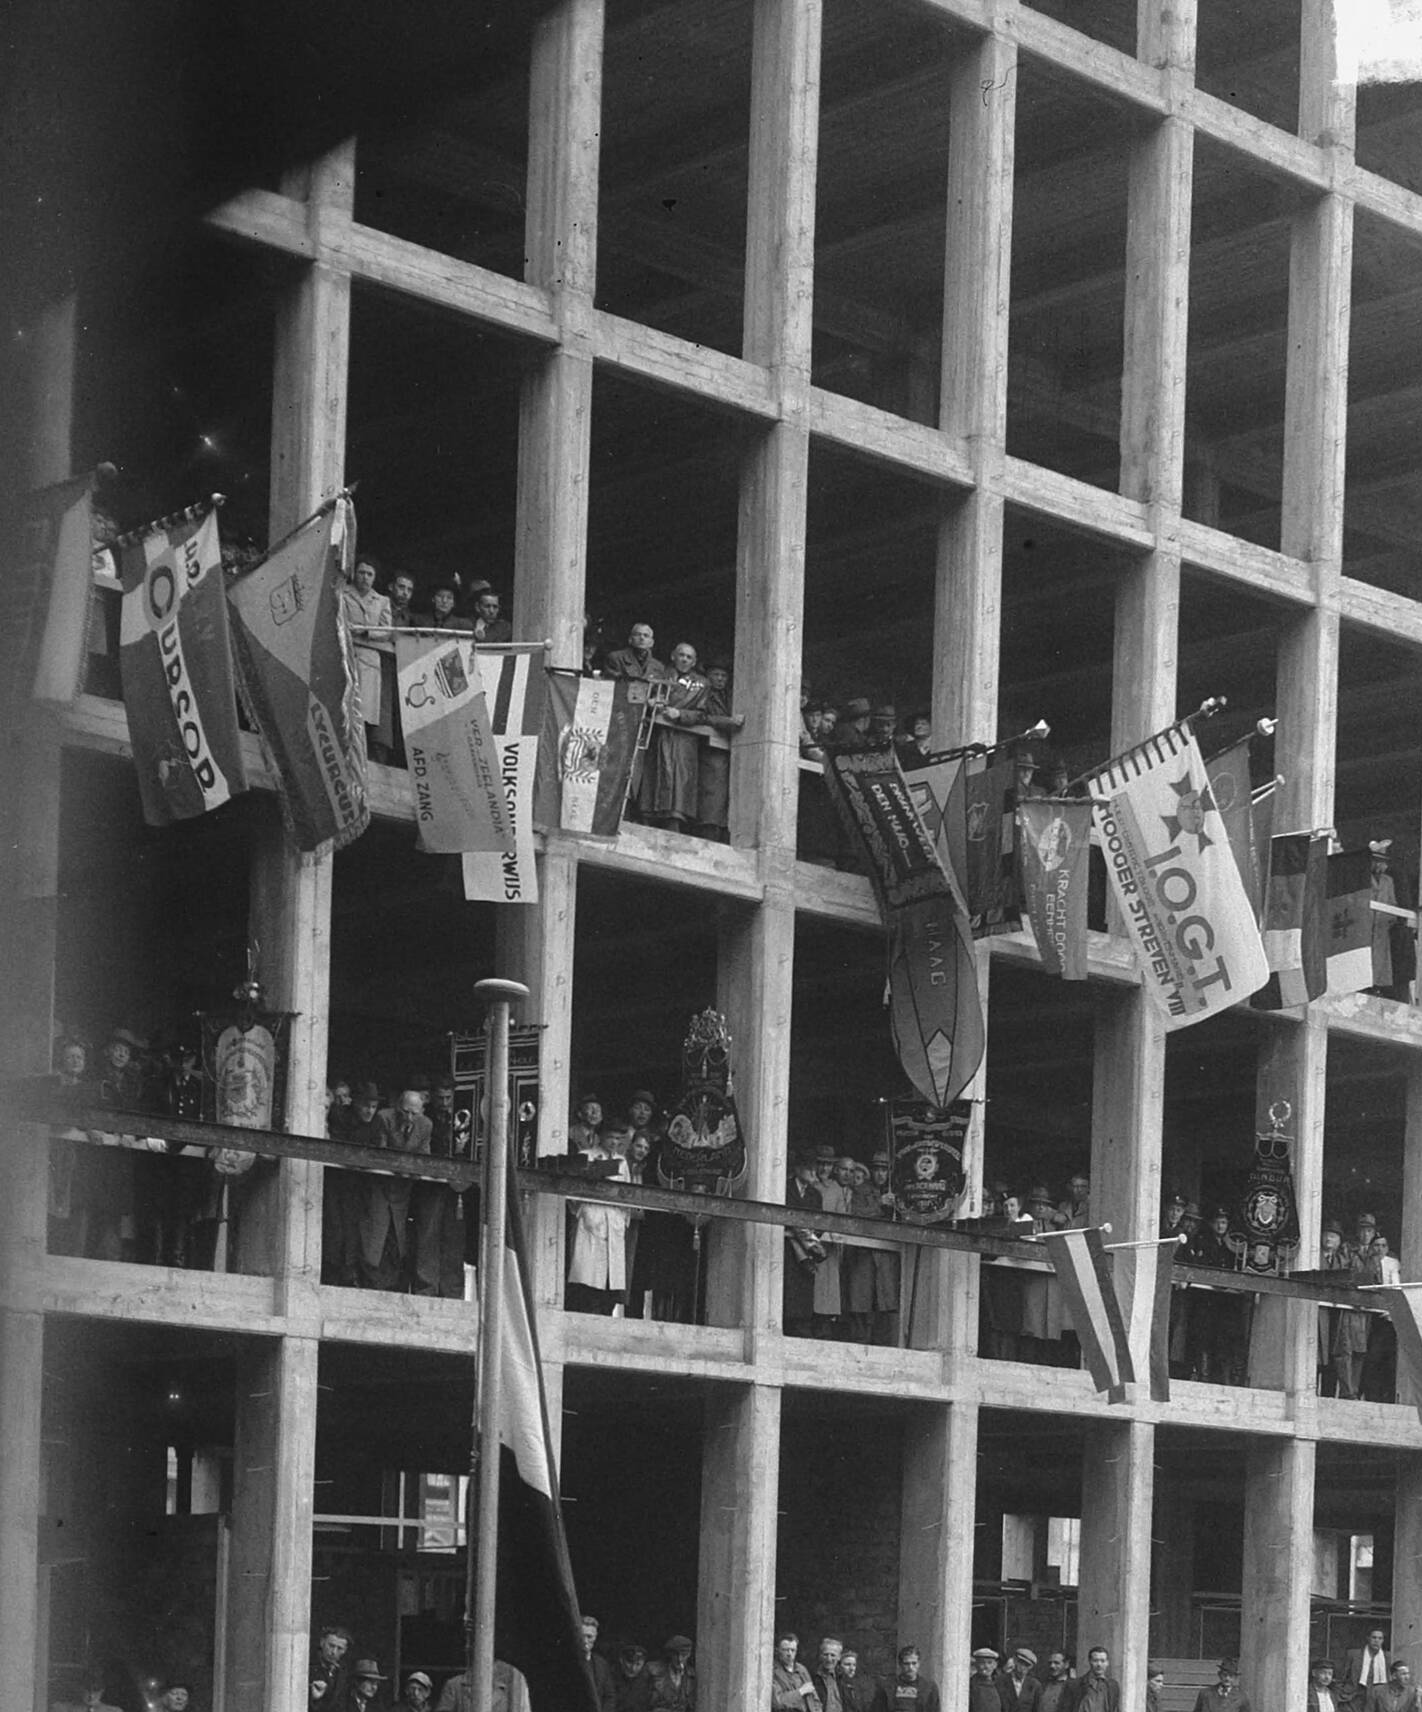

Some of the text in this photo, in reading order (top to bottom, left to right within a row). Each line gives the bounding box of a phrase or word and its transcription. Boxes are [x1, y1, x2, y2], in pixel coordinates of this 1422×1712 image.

[417, 783, 434, 822] ZANG
[502, 742, 521, 900] VOLKSORWIJS
[1057, 868, 1070, 928] KRACHT
